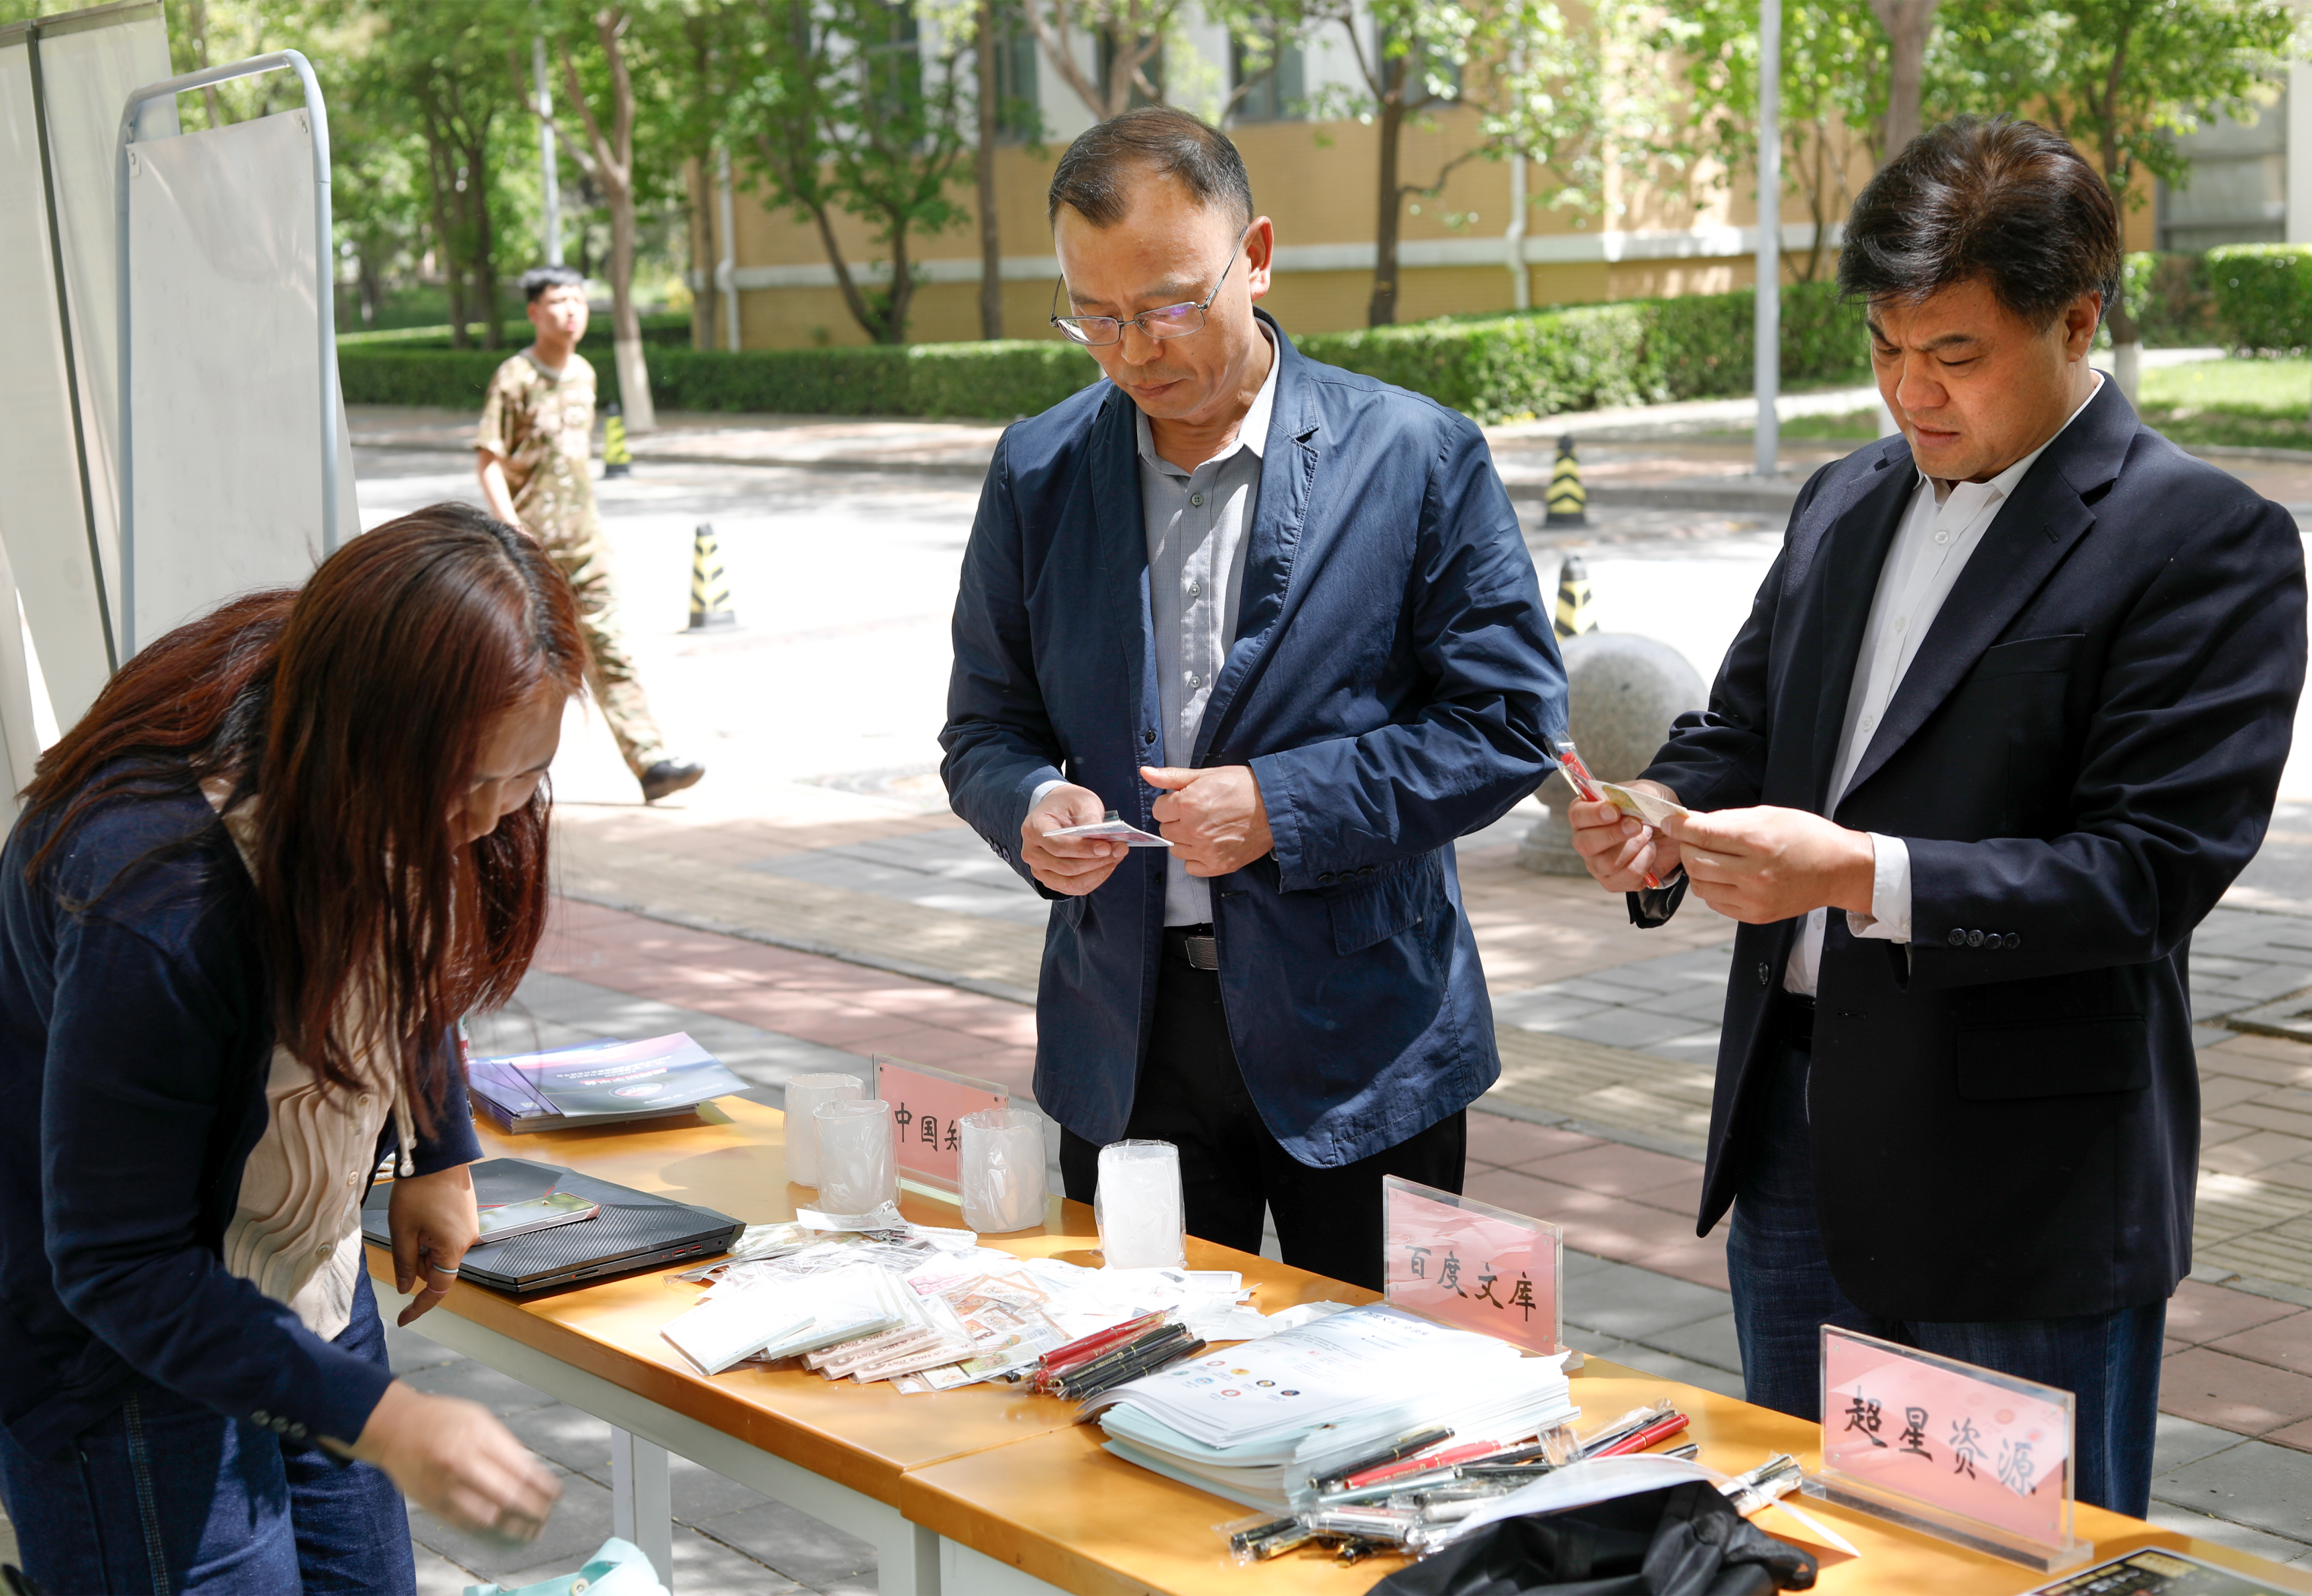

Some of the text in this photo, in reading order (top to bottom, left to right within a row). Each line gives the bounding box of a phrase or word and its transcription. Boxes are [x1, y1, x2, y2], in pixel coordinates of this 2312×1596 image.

[1405, 1245, 1537, 1322] 百度文库
[840, 1340, 859, 1350] DAY
[856, 1350, 875, 1360] DAY
[887, 1359, 906, 1368] DAY
[1844, 1385, 2037, 1498] 超星资源
